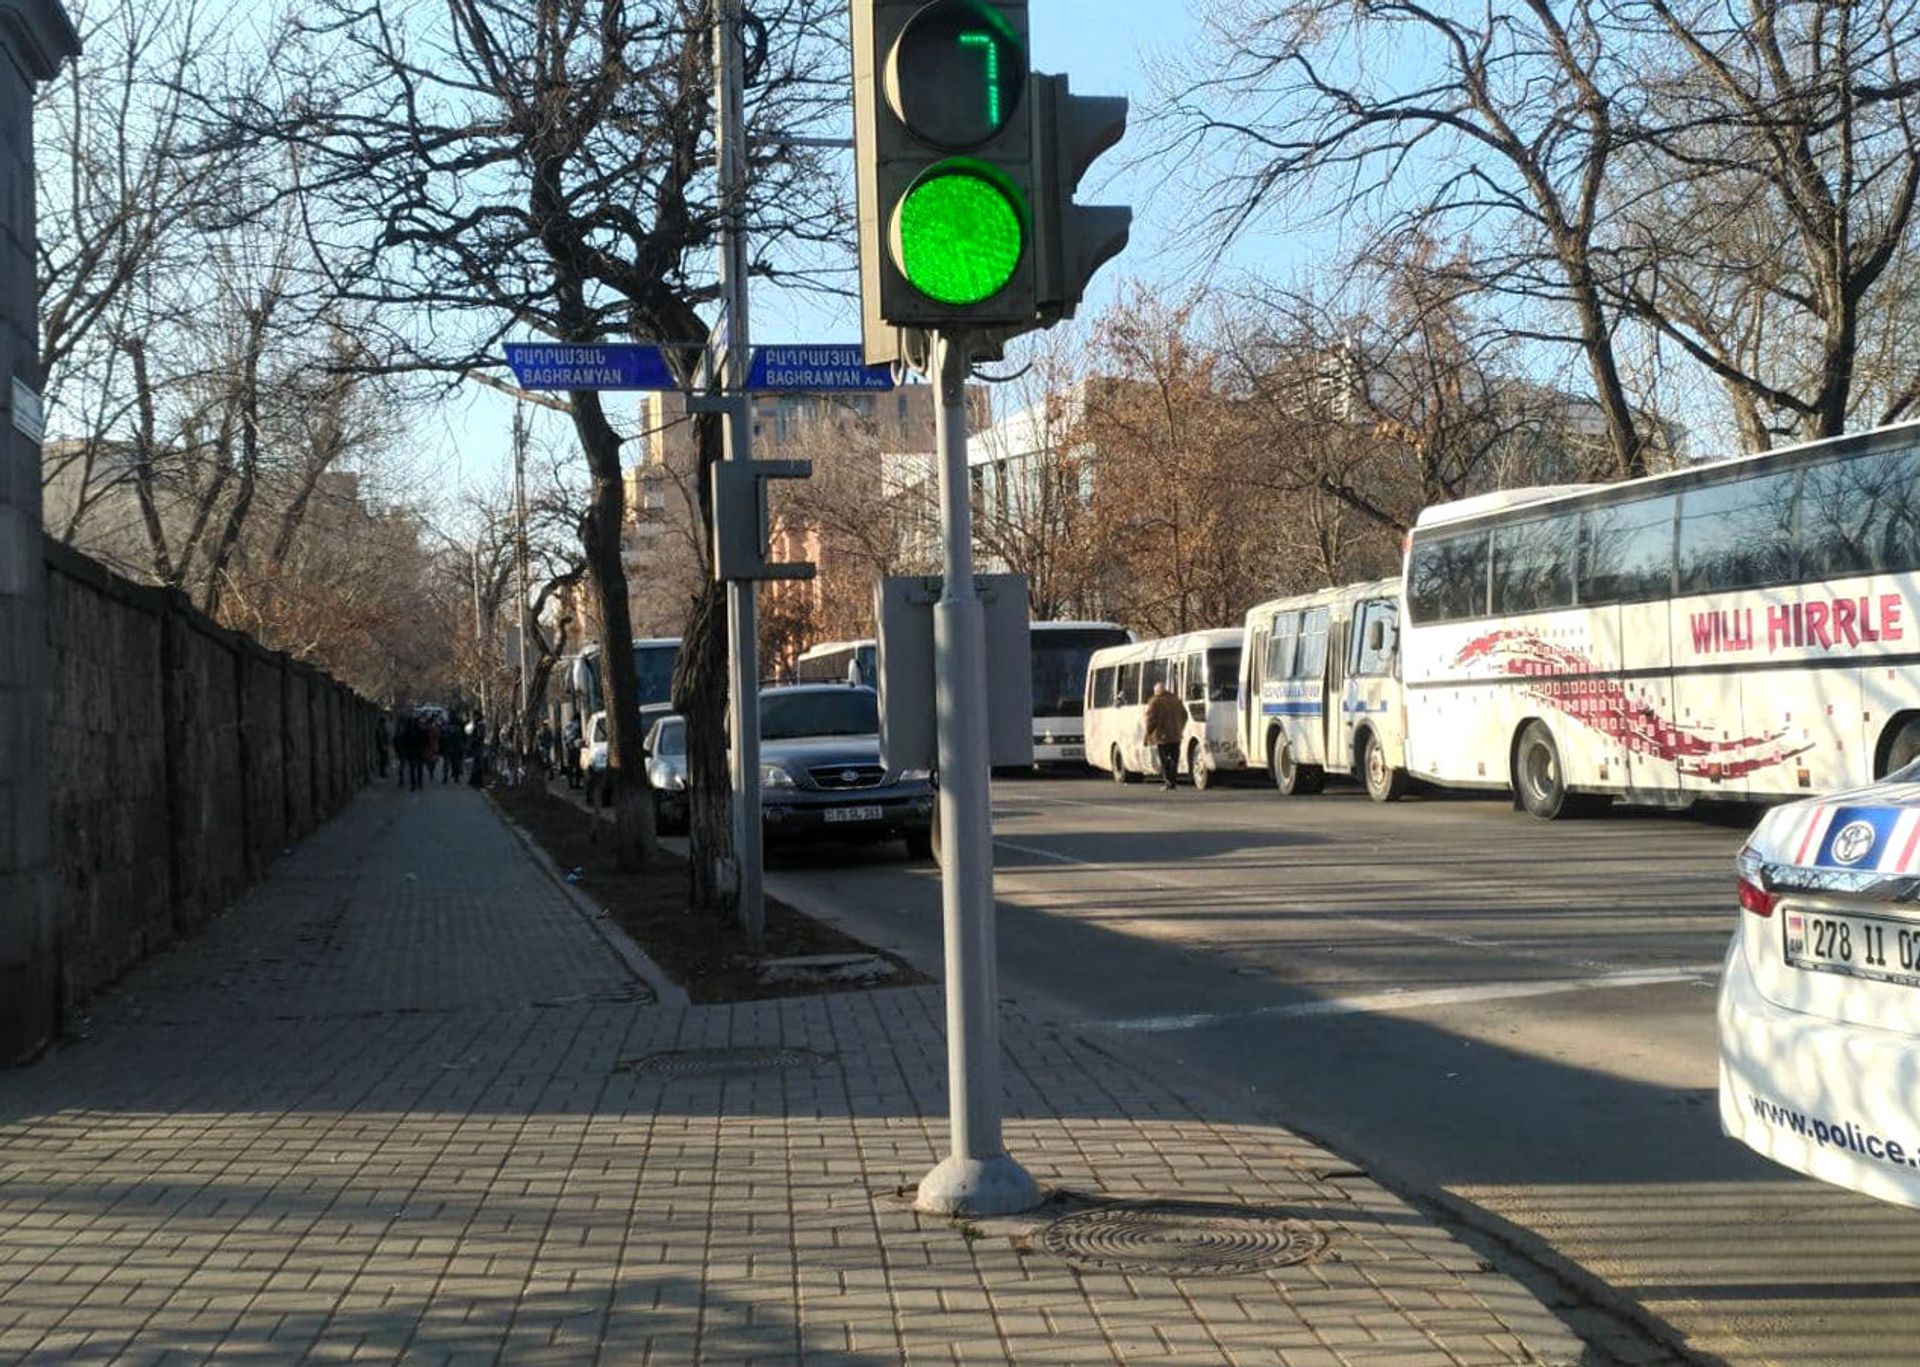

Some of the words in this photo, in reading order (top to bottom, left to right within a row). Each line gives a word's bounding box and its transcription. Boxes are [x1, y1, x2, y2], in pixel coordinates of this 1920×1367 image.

[523, 368, 621, 384] BAGHRAMYAN
[766, 370, 860, 386] BAGHRAMYAN
[1690, 608, 1753, 653] WILLI
[1767, 594, 1903, 655] HIRRLE
[1813, 919, 1852, 961] 278
[1749, 1094, 1920, 1169] www.police.
